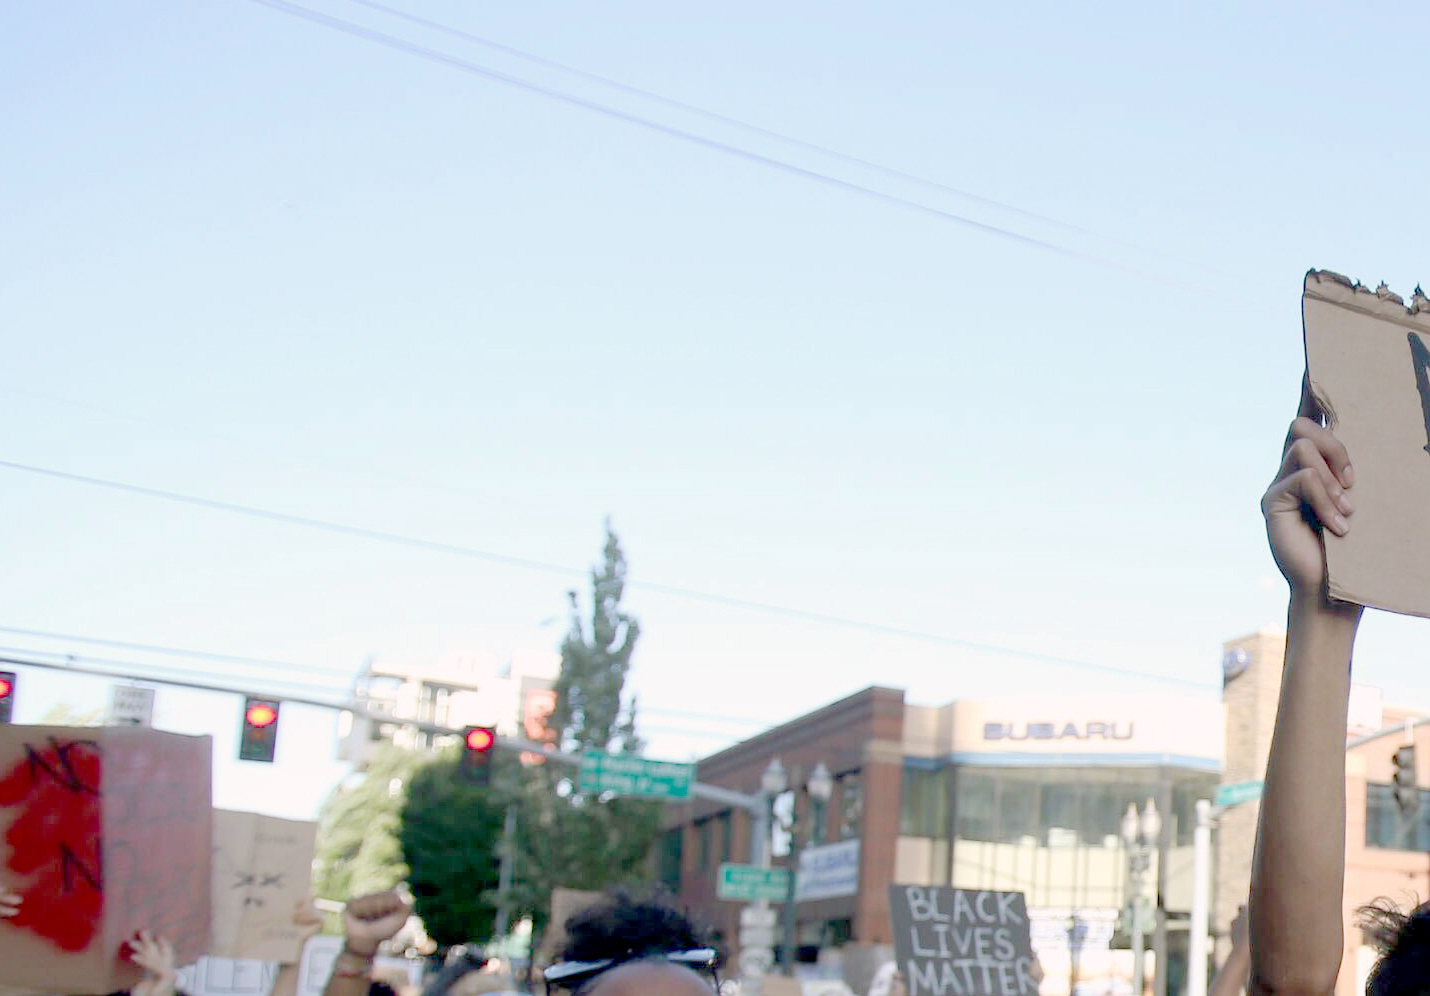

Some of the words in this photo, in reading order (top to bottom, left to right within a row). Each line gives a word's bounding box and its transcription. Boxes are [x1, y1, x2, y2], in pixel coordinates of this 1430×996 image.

[983, 722, 1134, 741] SUBARU
[906, 886, 1022, 925] BLACK
[909, 923, 1015, 960] LIVES
